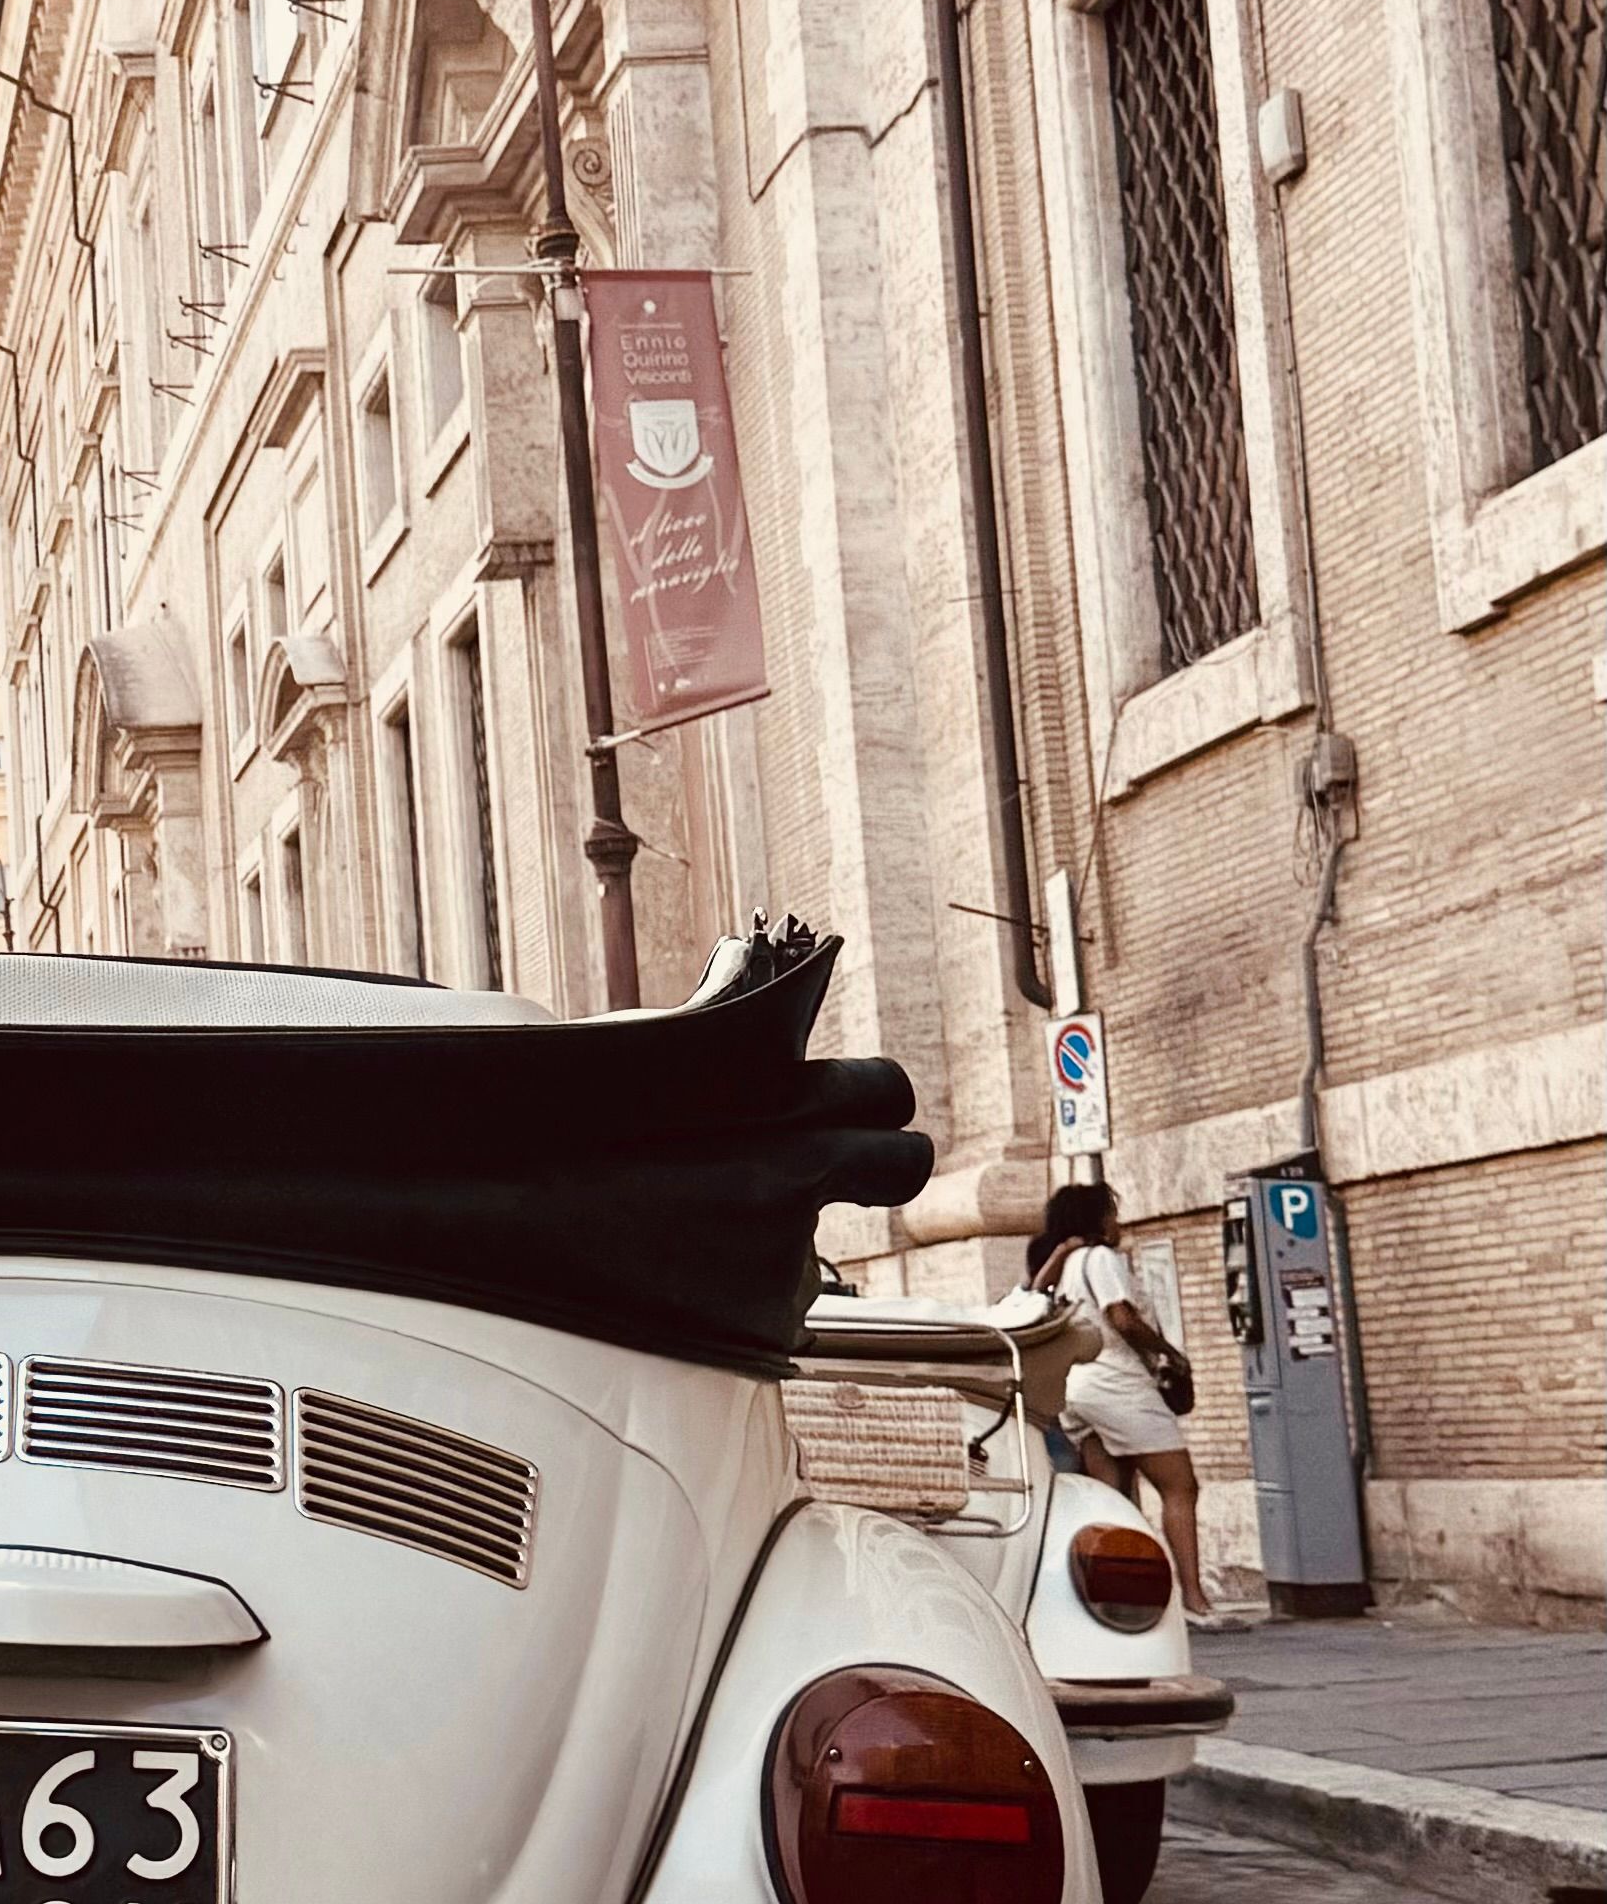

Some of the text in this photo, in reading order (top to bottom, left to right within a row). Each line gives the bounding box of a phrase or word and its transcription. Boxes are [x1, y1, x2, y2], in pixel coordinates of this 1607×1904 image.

[620, 334, 686, 350] Ennio
[622, 351, 689, 369] Quirino
[624, 369, 693, 385] Visconti
[651, 535, 702, 570] delle
[1280, 1188, 1309, 1232] P
